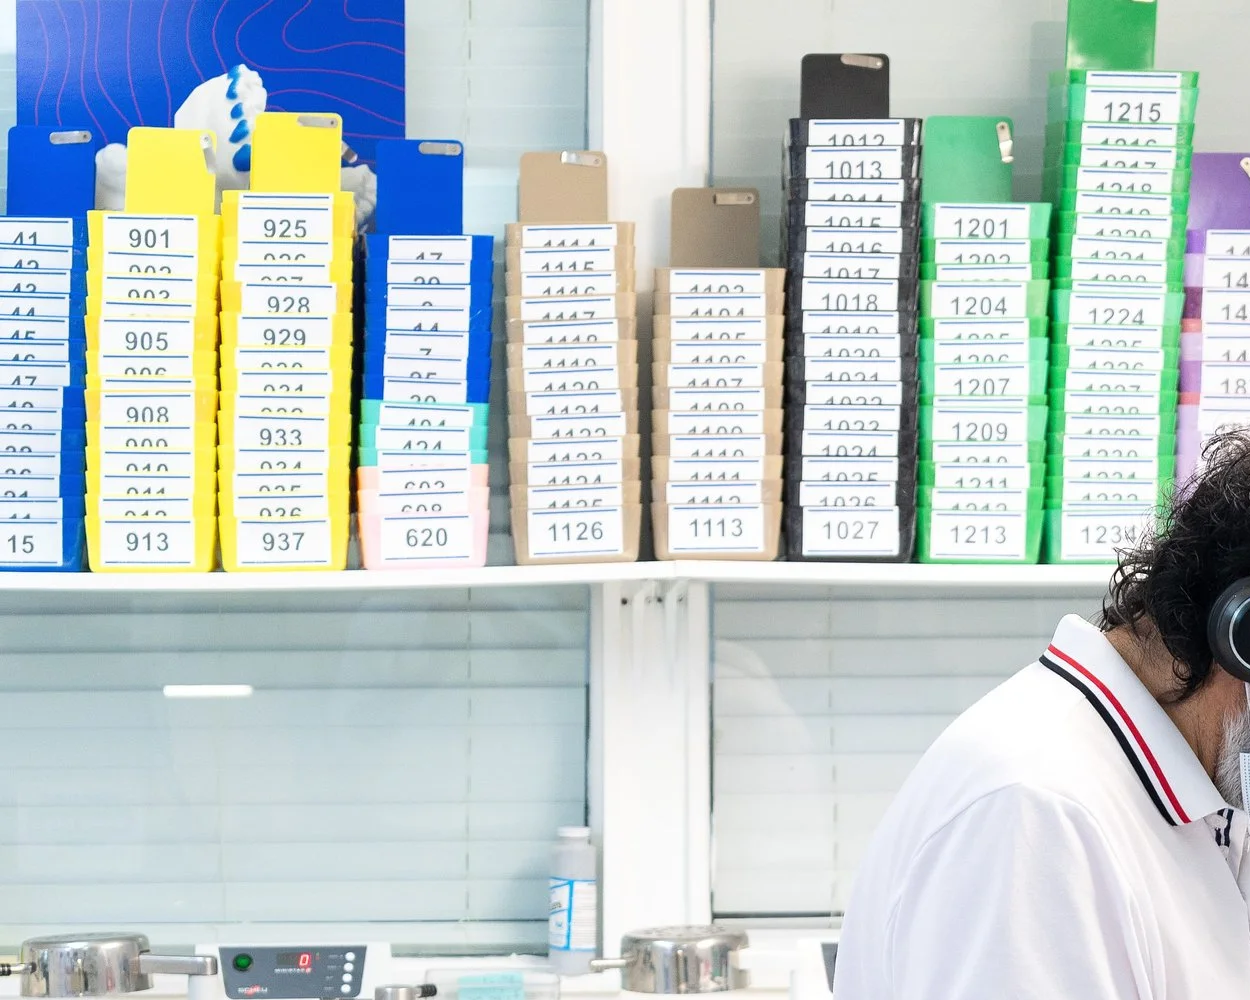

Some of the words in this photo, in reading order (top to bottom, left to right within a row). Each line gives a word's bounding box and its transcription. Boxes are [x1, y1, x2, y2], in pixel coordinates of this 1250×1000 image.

[1103, 102, 1161, 122] 1215
[826, 161, 882, 179] 1013
[263, 219, 307, 238] 925
[954, 218, 1009, 238] 1201
[129, 229, 171, 248] 901
[267, 296, 310, 312] 928
[821, 294, 878, 310] 1018
[951, 296, 1007, 315] 1204
[1088, 308, 1145, 325] 1224
[125, 332, 169, 351] 905
[263, 329, 306, 345] 929
[954, 378, 1010, 396] 1207
[126, 407, 169, 422] 908
[260, 428, 303, 445] 933
[952, 422, 1008, 441] 1209
[406, 527, 448, 547] 620
[548, 522, 604, 542] 1126
[689, 518, 743, 537] 1113
[823, 521, 880, 540] 1027
[950, 526, 1006, 544] 1213
[7, 534, 35, 553] 15
[126, 532, 169, 551] 913
[262, 532, 305, 551] 937
[299, 953, 310, 966] 0
